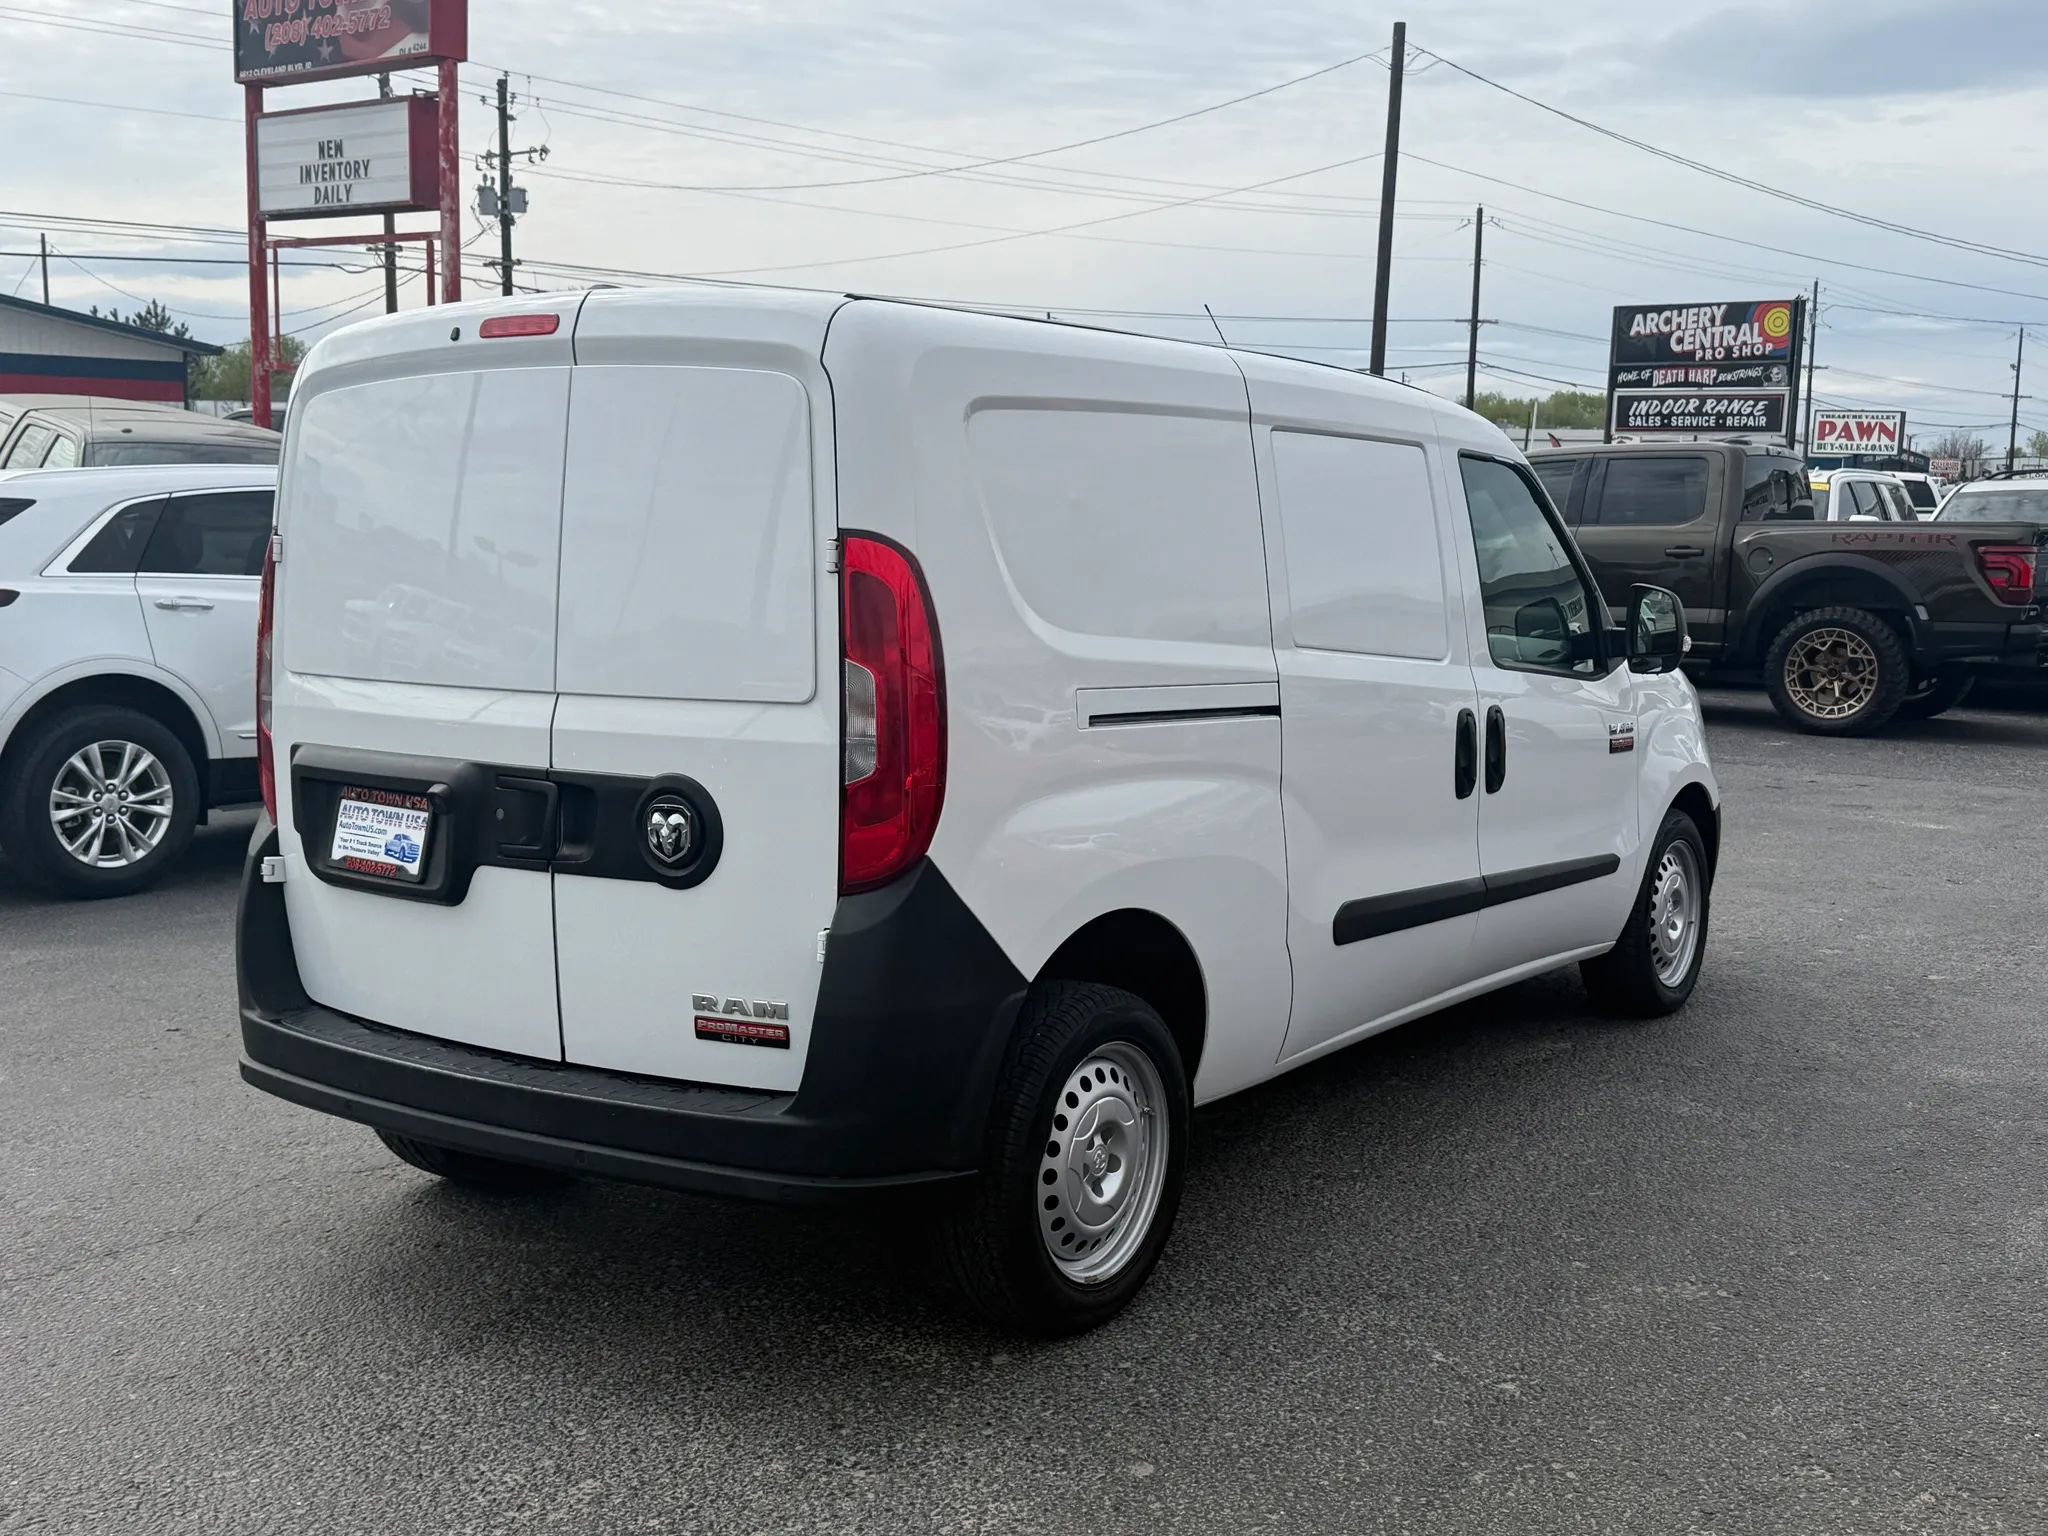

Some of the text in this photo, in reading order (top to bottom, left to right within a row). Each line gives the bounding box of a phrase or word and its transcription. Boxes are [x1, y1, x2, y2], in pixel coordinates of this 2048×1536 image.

[265, 5, 391, 51] (208) 402-5772
[318, 139, 344, 160] NEW
[300, 159, 370, 184] INVENTORY
[314, 184, 353, 205] DAILY
[1629, 304, 1728, 337] ARCHERY
[1670, 322, 1764, 352] CENTRAL
[1695, 343, 1774, 361] PRO SHOP
[1617, 366, 1764, 387] HOME OF DEATH HARP BOWSTRINGS
[1629, 399, 1769, 416] INDOOR RANGE
[1628, 416, 1767, 427] SALES SERVICE REPAIR
[1817, 420, 1897, 443] PAWN
[1831, 532, 1957, 546] RAPTOR
[342, 785, 429, 810] AUTO TOWN USA
[340, 803, 428, 832] AUTO TOWN USA
[692, 993, 789, 1020] RAM
[721, 1033, 758, 1044] CITY
